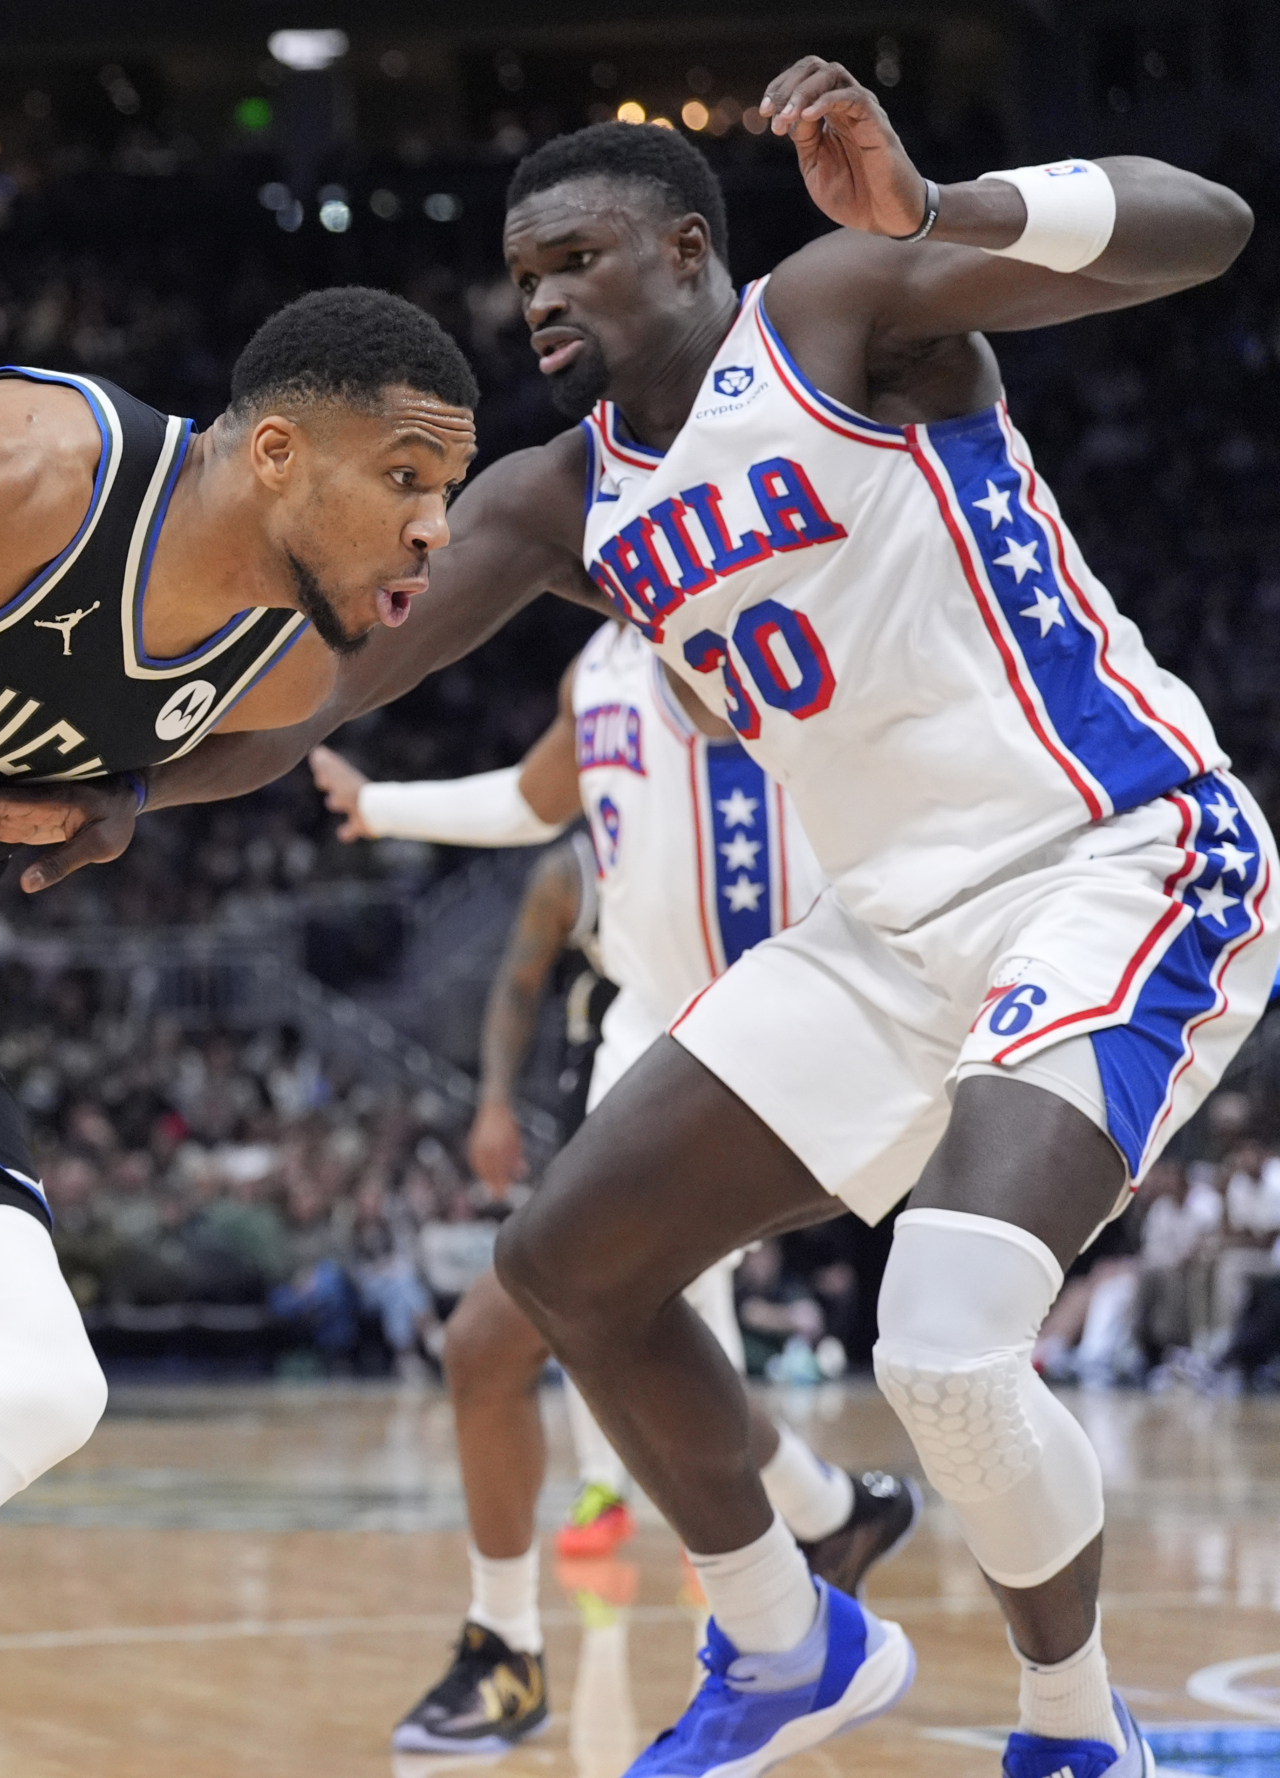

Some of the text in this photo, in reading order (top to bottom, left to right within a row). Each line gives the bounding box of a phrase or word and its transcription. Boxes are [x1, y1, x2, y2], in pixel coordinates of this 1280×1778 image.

[695, 381, 769, 419] crypto.m
[588, 456, 848, 643] PHILA
[683, 598, 837, 741] 30
[970, 981, 1048, 1036] 76
